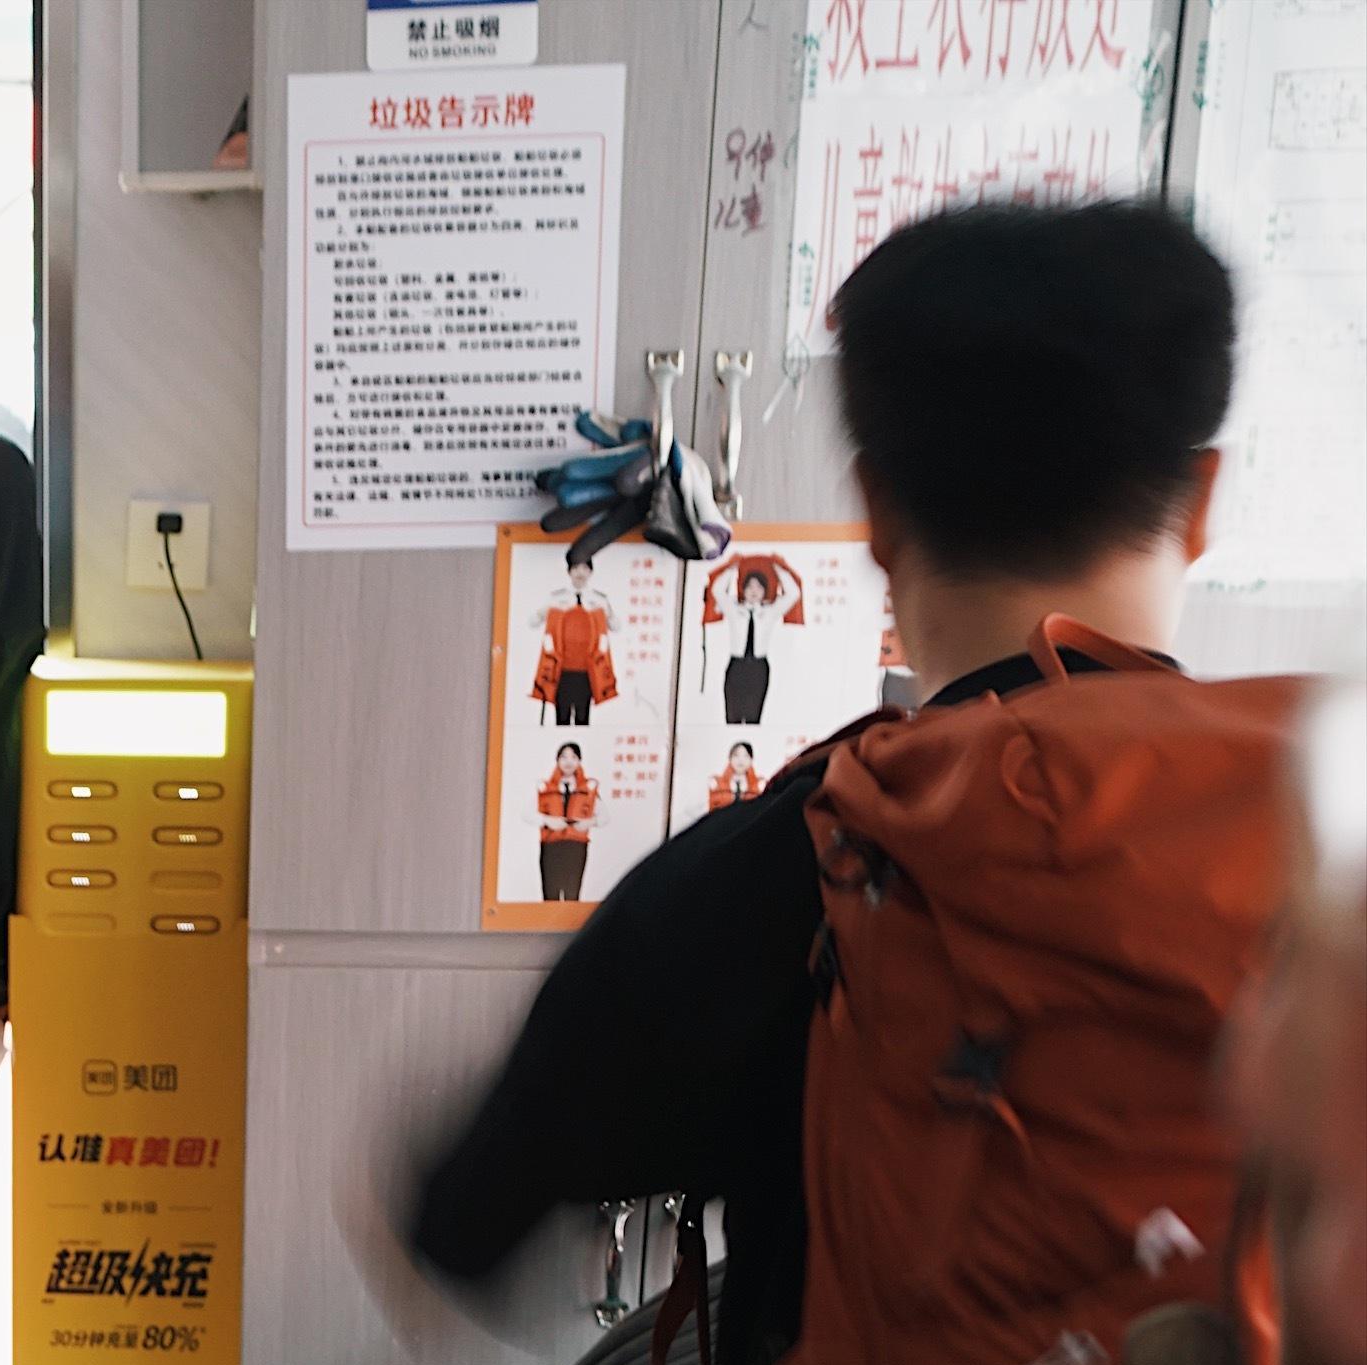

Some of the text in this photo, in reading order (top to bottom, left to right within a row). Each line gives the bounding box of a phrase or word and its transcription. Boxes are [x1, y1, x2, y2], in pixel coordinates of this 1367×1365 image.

[407, 16, 500, 41] 禁止吸烟
[409, 43, 497, 59] NO SMOKING
[369, 92, 535, 129] 垃圾告示牌
[123, 1065, 178, 1092] 美团
[46, 1248, 214, 1299] 超级快充
